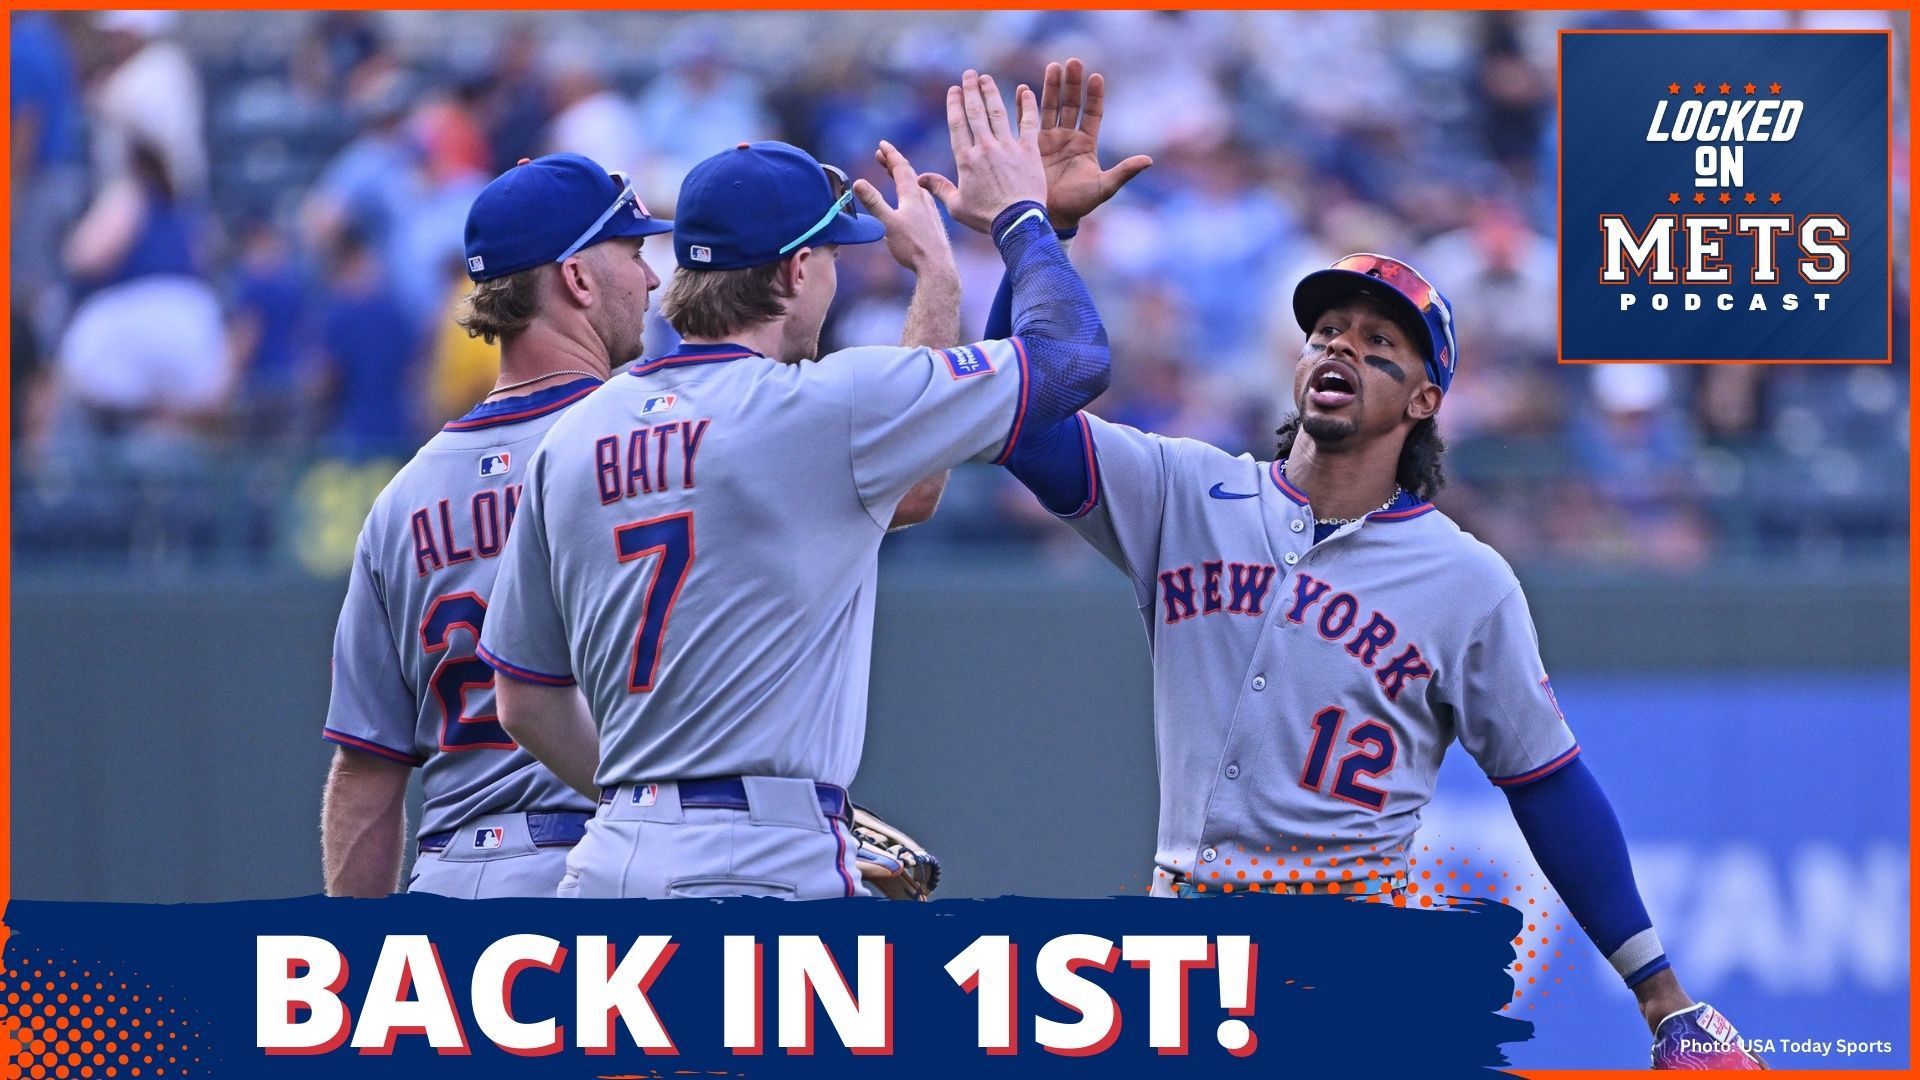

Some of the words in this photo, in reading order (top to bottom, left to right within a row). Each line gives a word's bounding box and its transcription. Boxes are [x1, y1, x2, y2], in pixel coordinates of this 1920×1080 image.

[595, 417, 711, 506] BATY
[419, 591, 519, 753] 2
[613, 510, 695, 695] 7
[1158, 560, 1277, 625] NEW
[1284, 572, 1434, 701] YORK
[1300, 705, 1398, 813] 12
